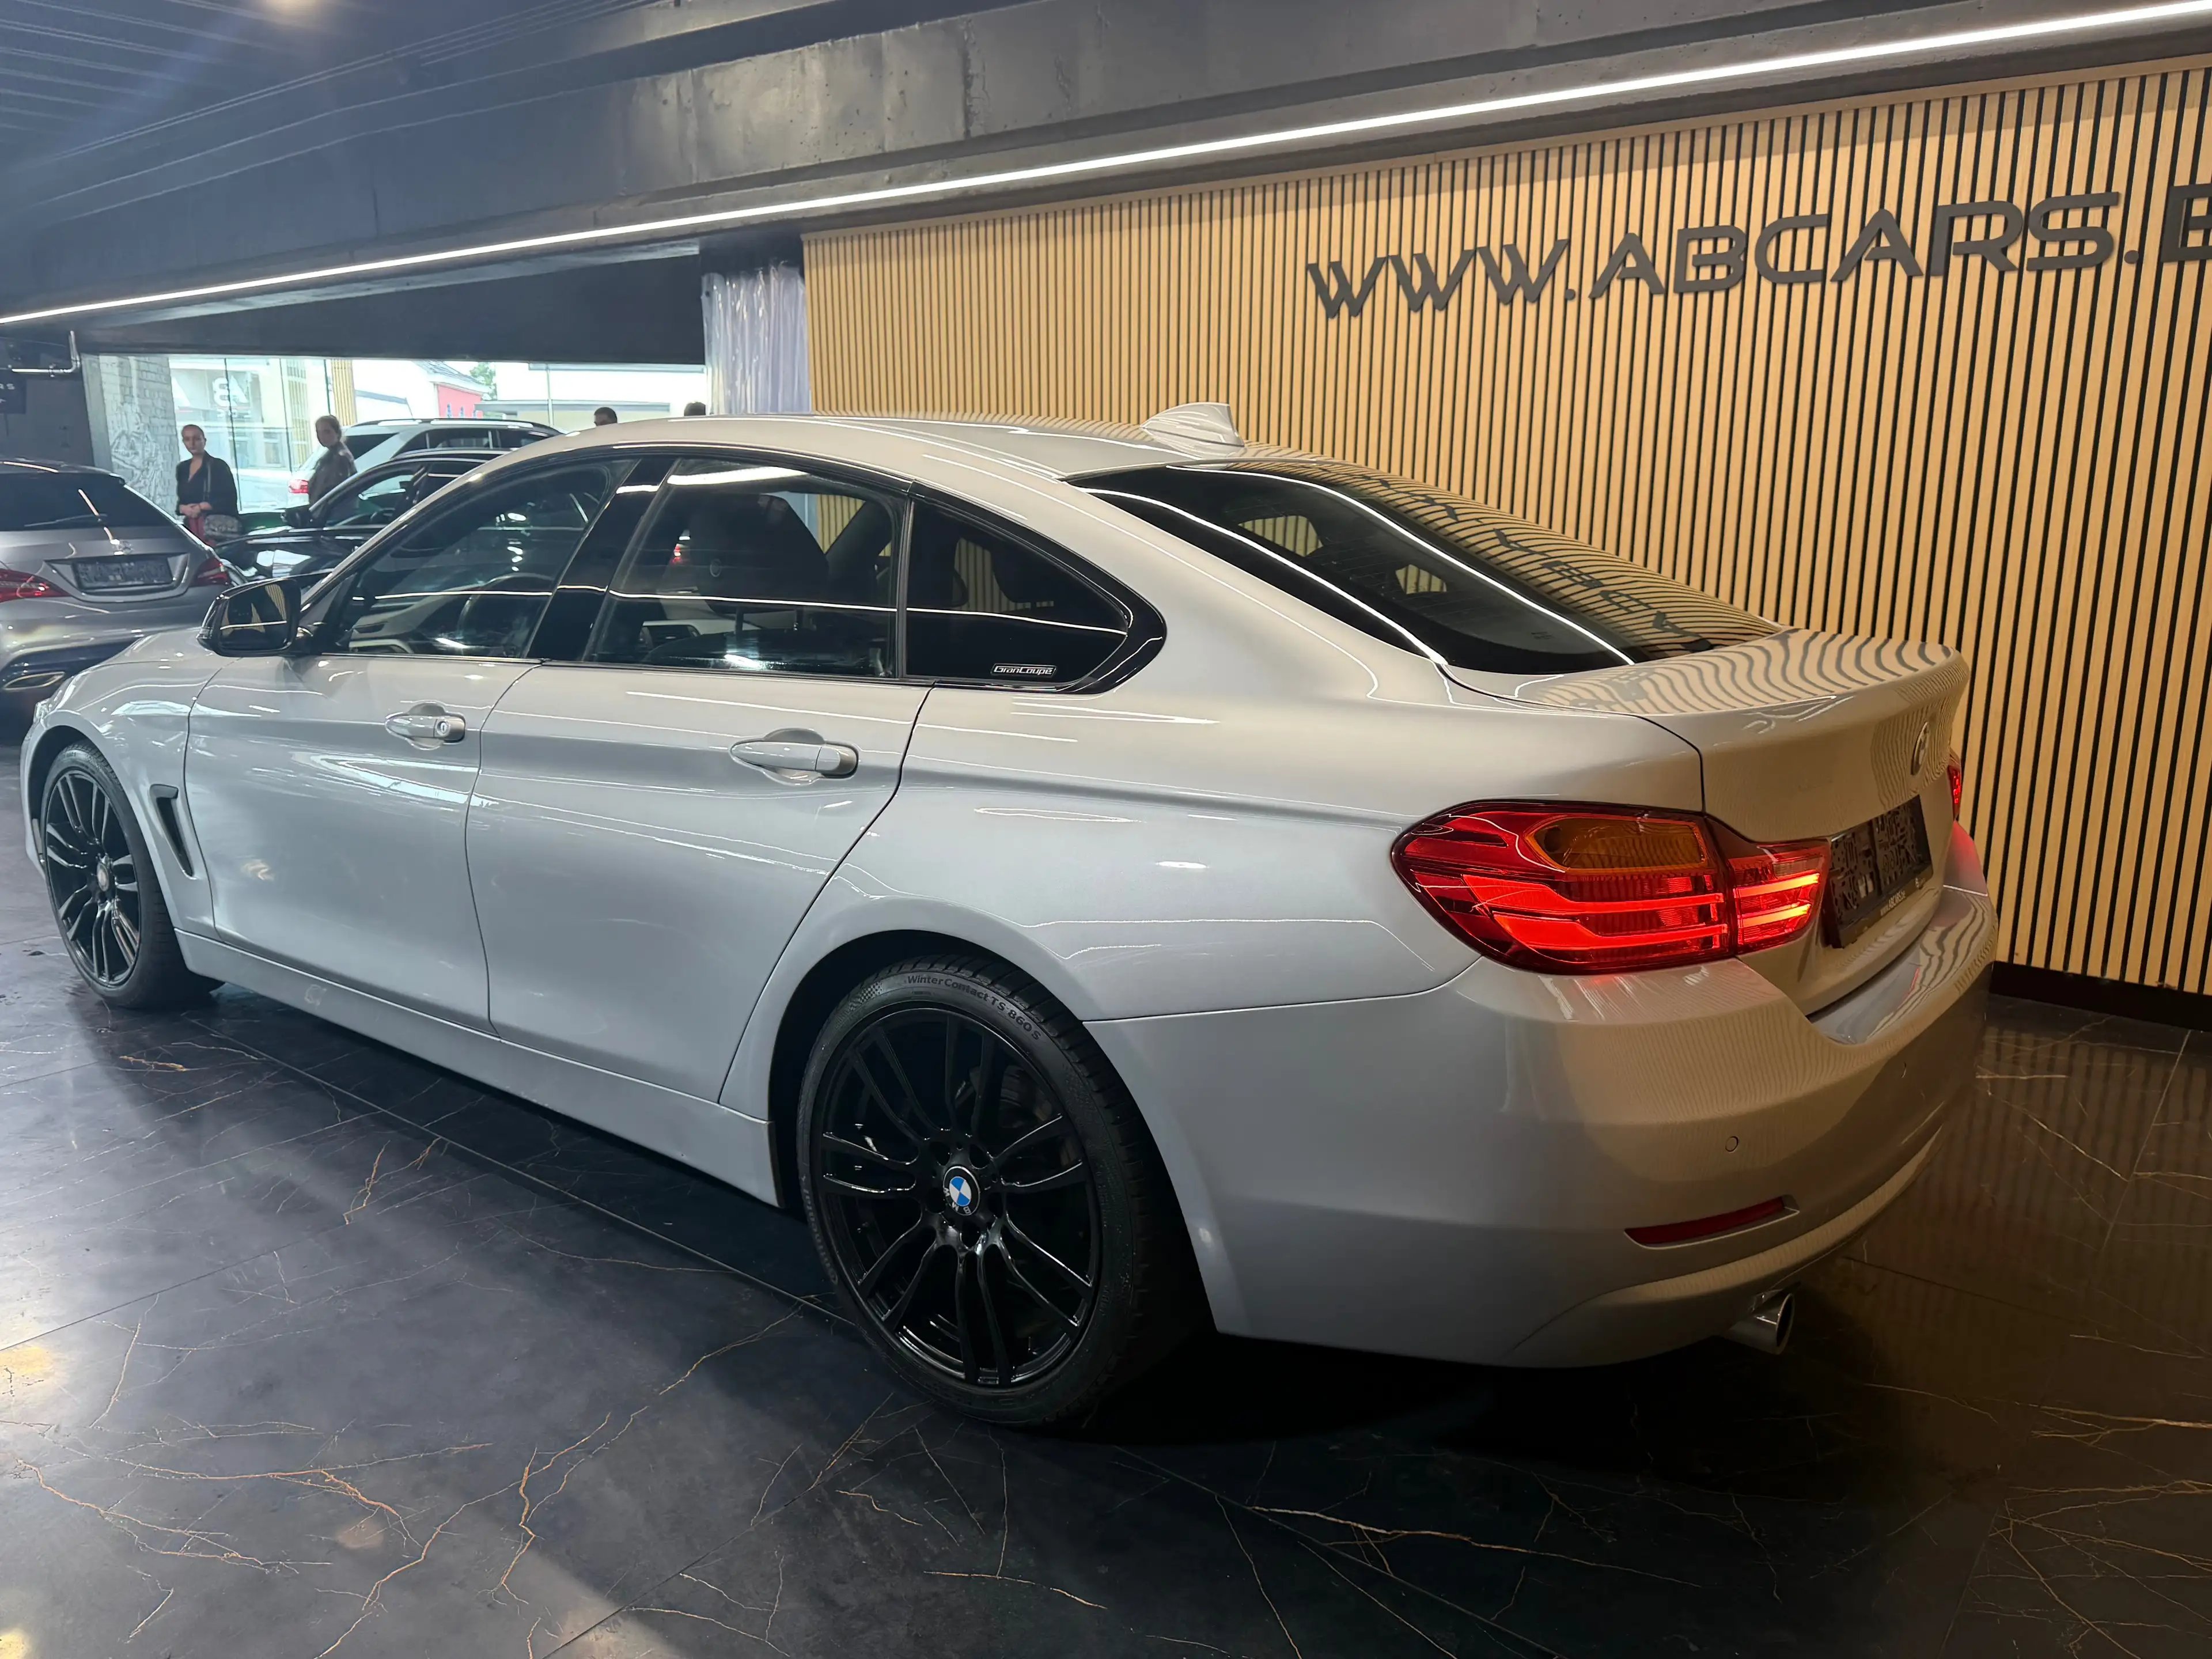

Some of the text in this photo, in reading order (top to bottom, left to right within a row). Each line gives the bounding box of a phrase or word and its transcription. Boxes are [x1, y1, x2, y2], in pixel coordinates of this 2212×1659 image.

[990, 996, 1005, 1011] TS
[1008, 1010, 1032, 1031] 860
[1032, 1031, 1041, 1040] S
[943, 1187, 971, 1214] BMW
